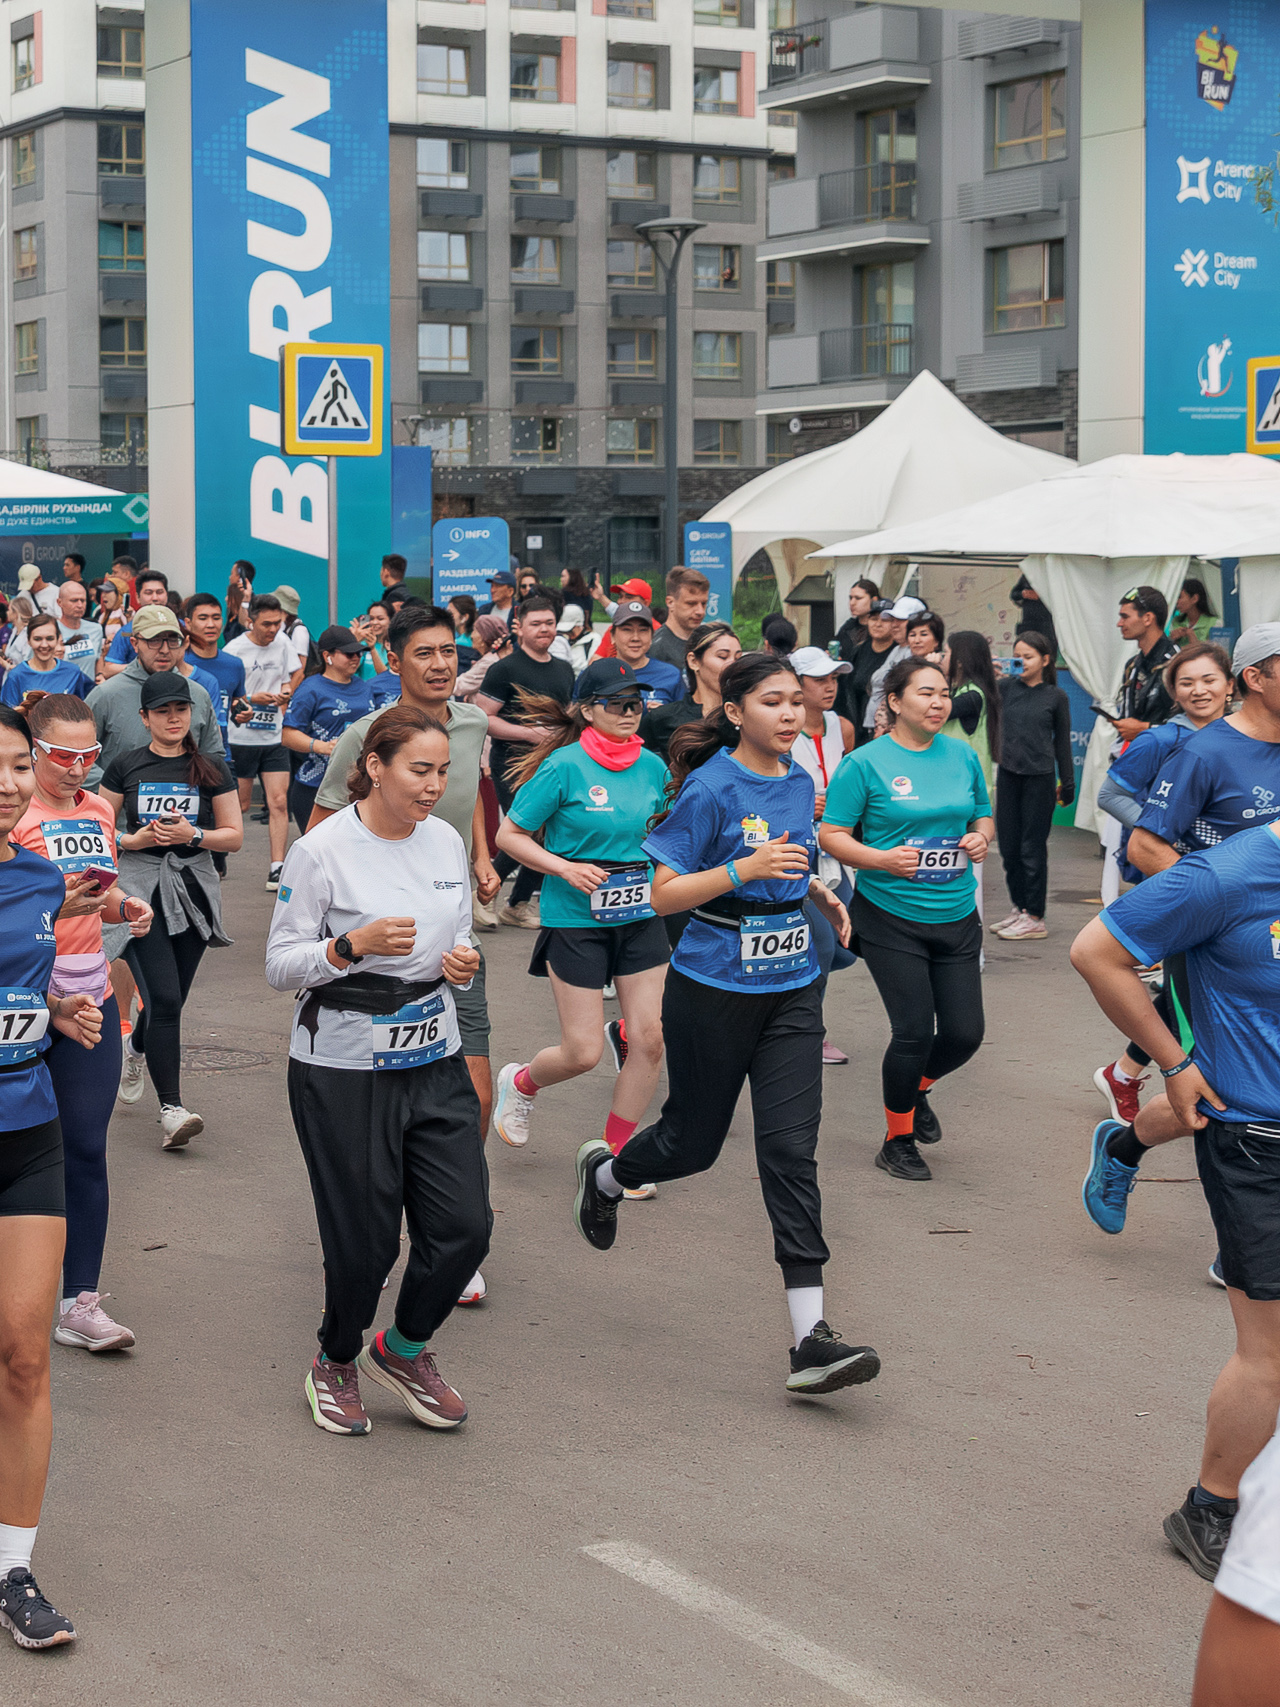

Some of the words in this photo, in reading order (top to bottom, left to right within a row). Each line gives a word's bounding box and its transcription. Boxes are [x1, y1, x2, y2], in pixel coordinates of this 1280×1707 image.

[1201, 69, 1215, 85] BI
[1203, 84, 1230, 100] RUN
[1213, 159, 1256, 178] Arena
[1213, 180, 1243, 203] City
[245, 46, 333, 363] RUN
[1213, 252, 1257, 269] Dream
[1213, 269, 1241, 290] City
[52, 503, 112, 514] РУХЫНДА!
[0, 518, 5, 526] В
[7, 517, 29, 527] ДУХЕ
[31, 516, 77, 526] ЕДИНСТВА
[465, 529, 491, 539] INFO
[440, 584, 477, 592] КАМЕРА
[441, 593, 489, 602] ХРНИЯ
[146, 797, 191, 813] 1104
[44, 824, 50, 832] 5
[53, 835, 104, 857] 1009
[917, 851, 960, 867] 1661
[600, 886, 644, 908] 1235
[751, 928, 805, 957] 1046
[389, 1018, 439, 1049] 1716
